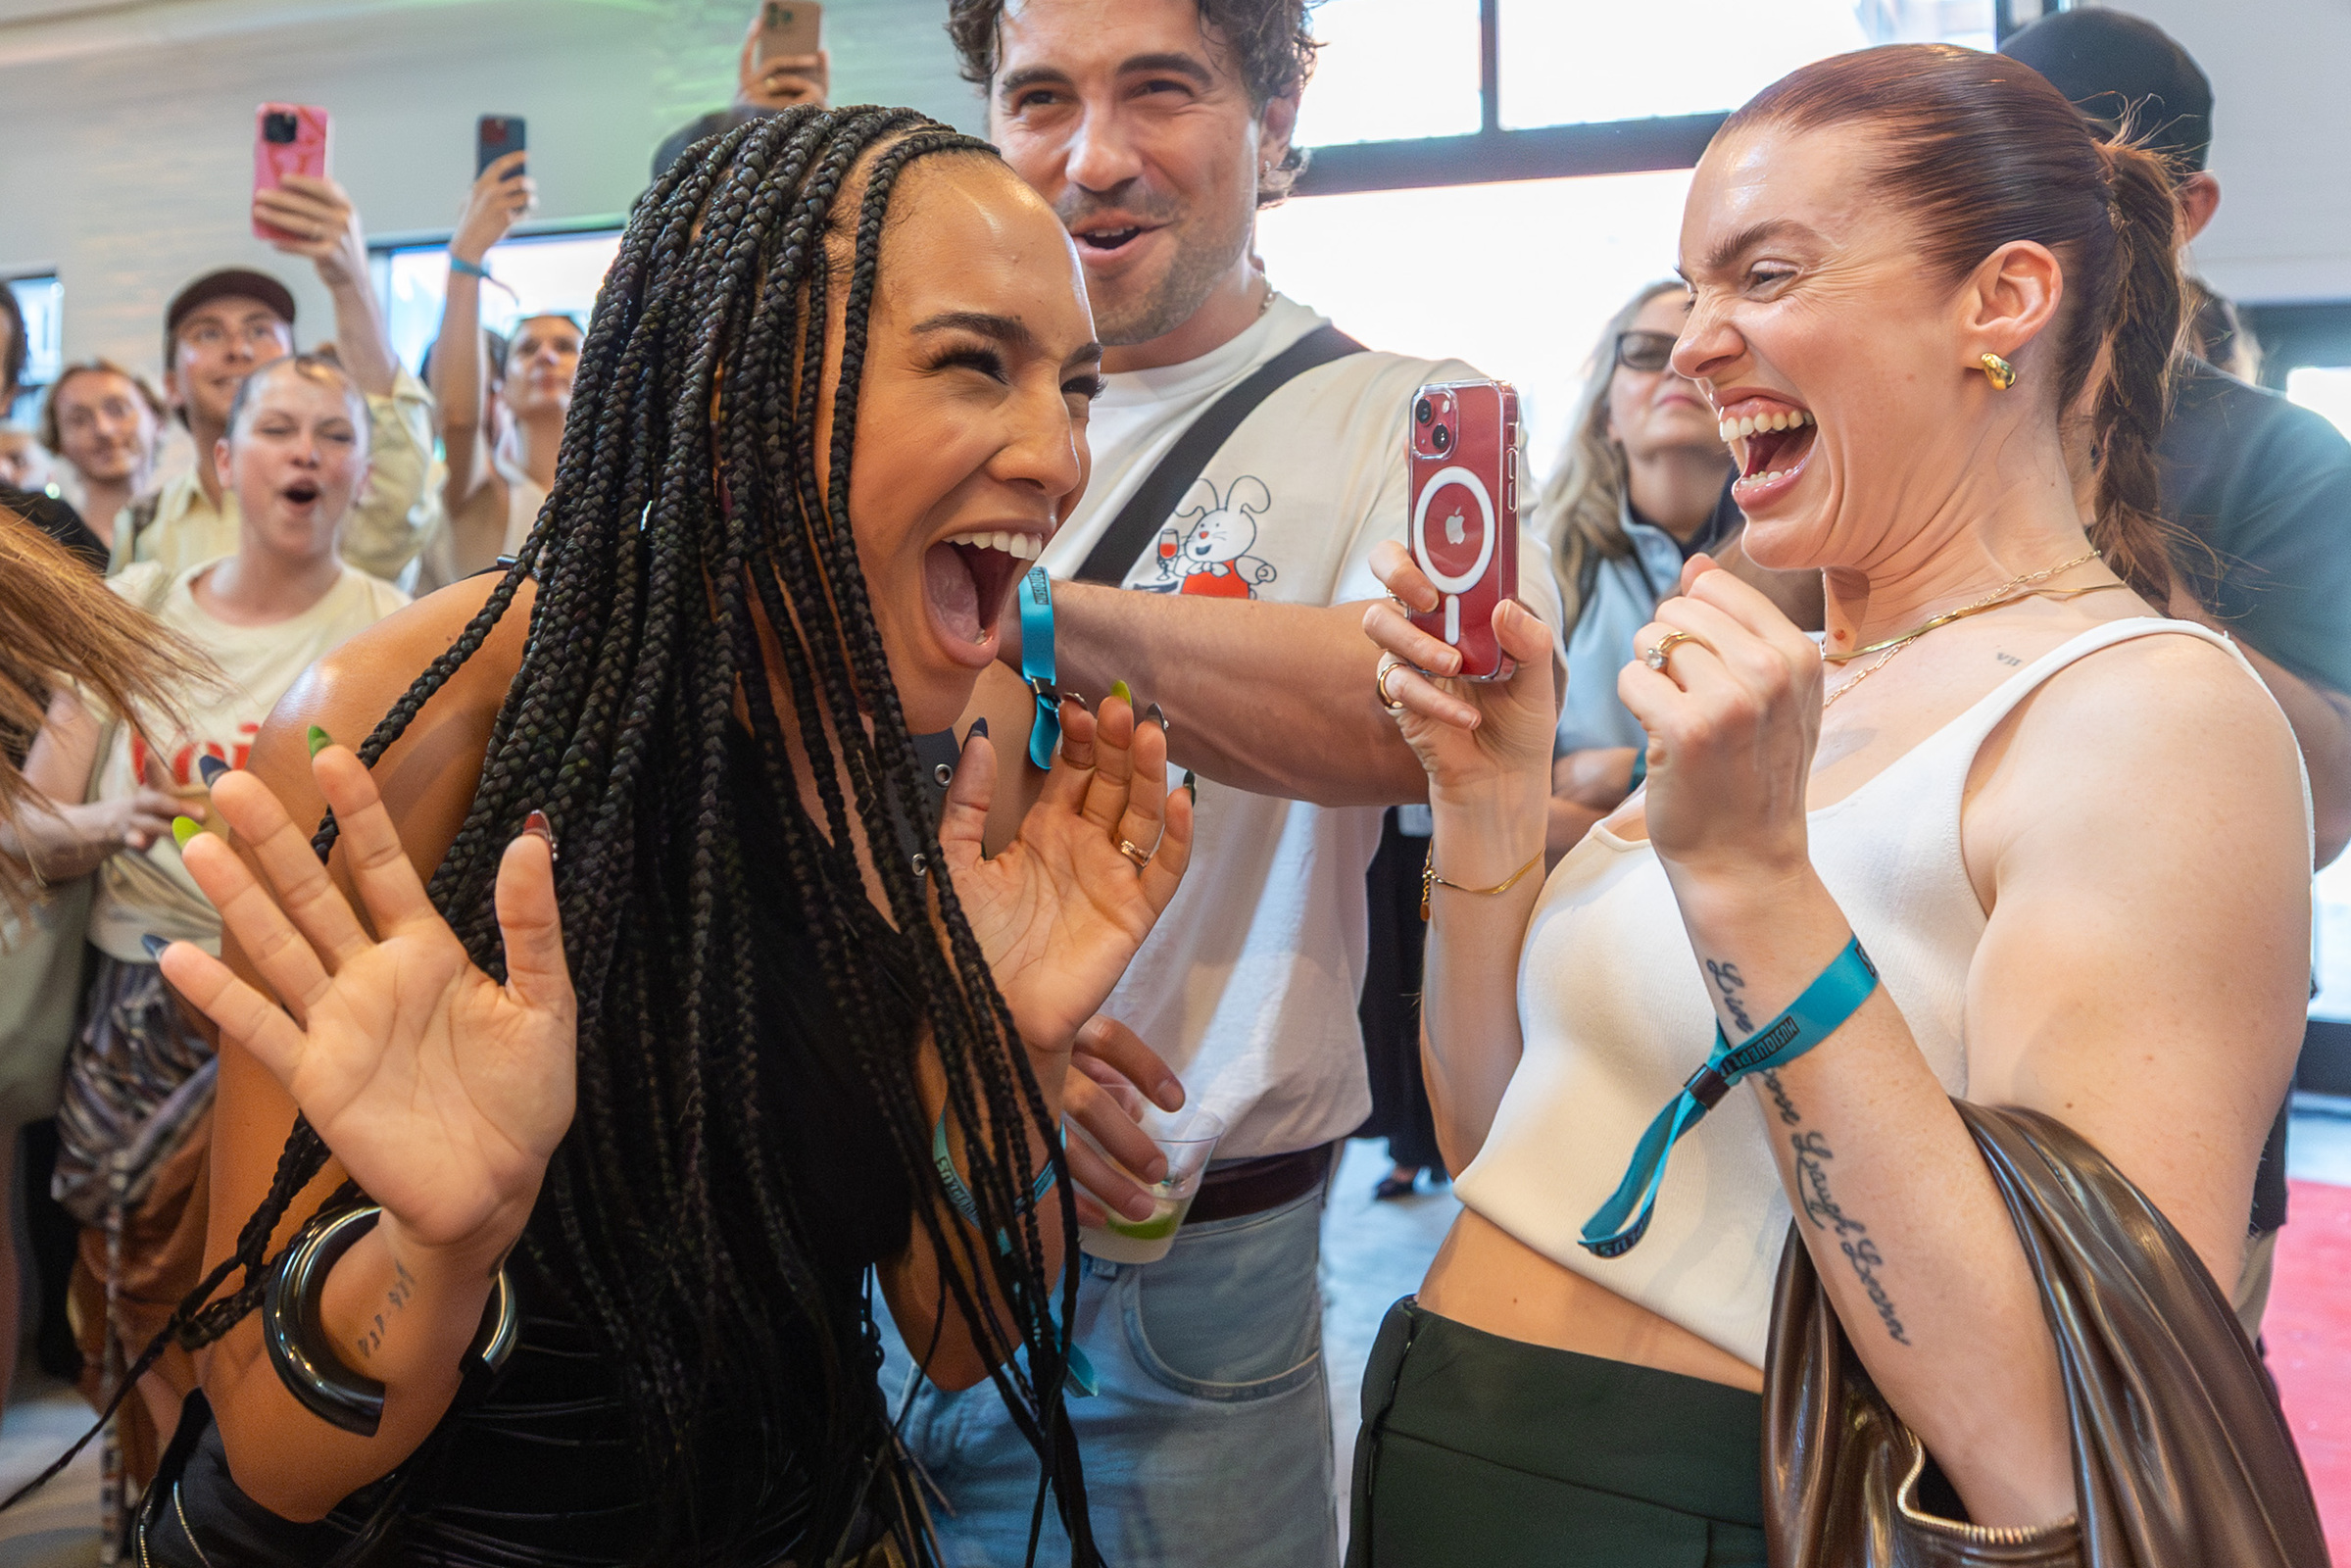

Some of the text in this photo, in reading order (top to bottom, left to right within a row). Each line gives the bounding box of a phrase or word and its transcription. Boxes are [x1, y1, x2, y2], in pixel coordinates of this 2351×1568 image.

[1705, 958, 1754, 1033] Live
[1762, 1070, 1801, 1125] ove
[1790, 1129, 1866, 1237] Laugh
